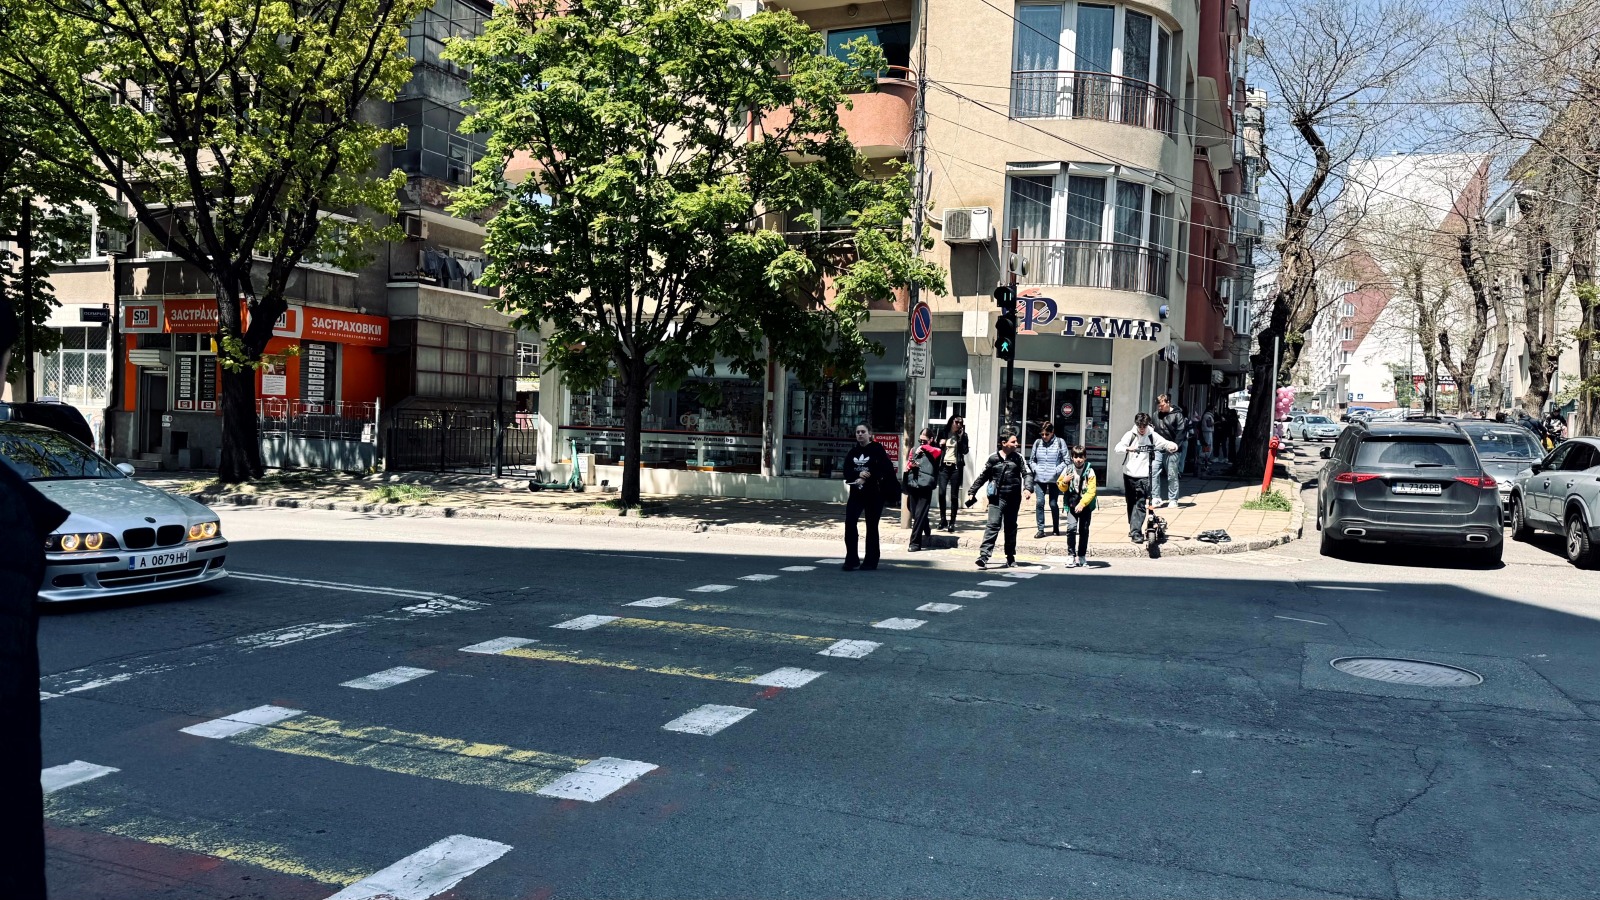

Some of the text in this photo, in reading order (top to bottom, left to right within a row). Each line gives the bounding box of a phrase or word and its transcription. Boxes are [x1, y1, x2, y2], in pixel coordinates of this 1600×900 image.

[134, 311, 148, 320] SDI
[312, 317, 382, 335] ЗАСТРАХОВКИ
[687, 435, 734, 443] www.framar.bg
[140, 557, 146, 568] A
[152, 554, 175, 566] 0879
[176, 551, 188, 563] HH
